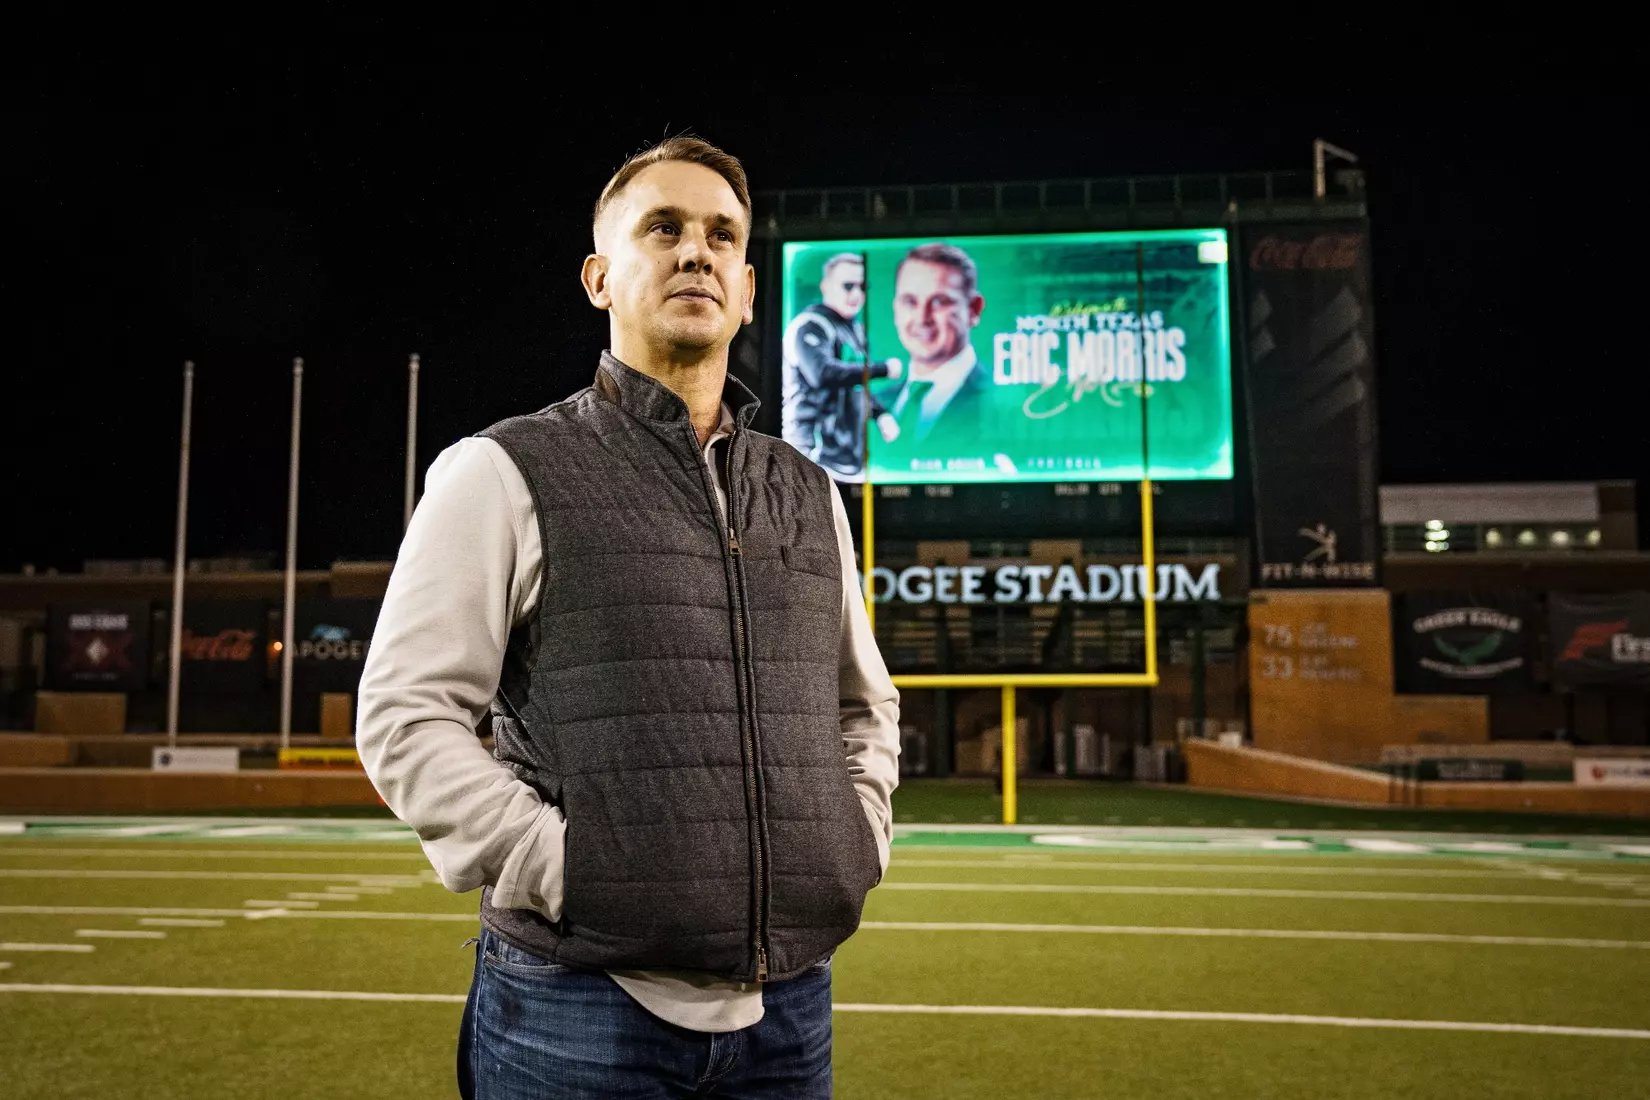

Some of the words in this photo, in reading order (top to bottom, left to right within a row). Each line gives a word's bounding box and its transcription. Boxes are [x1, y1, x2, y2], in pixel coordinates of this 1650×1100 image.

[1016, 312, 1090, 332] NORTH
[1096, 310, 1163, 331] TEXAS
[993, 331, 1060, 385] ERIC
[1067, 327, 1186, 382] MORRIS
[993, 563, 1221, 604] STADIUM
